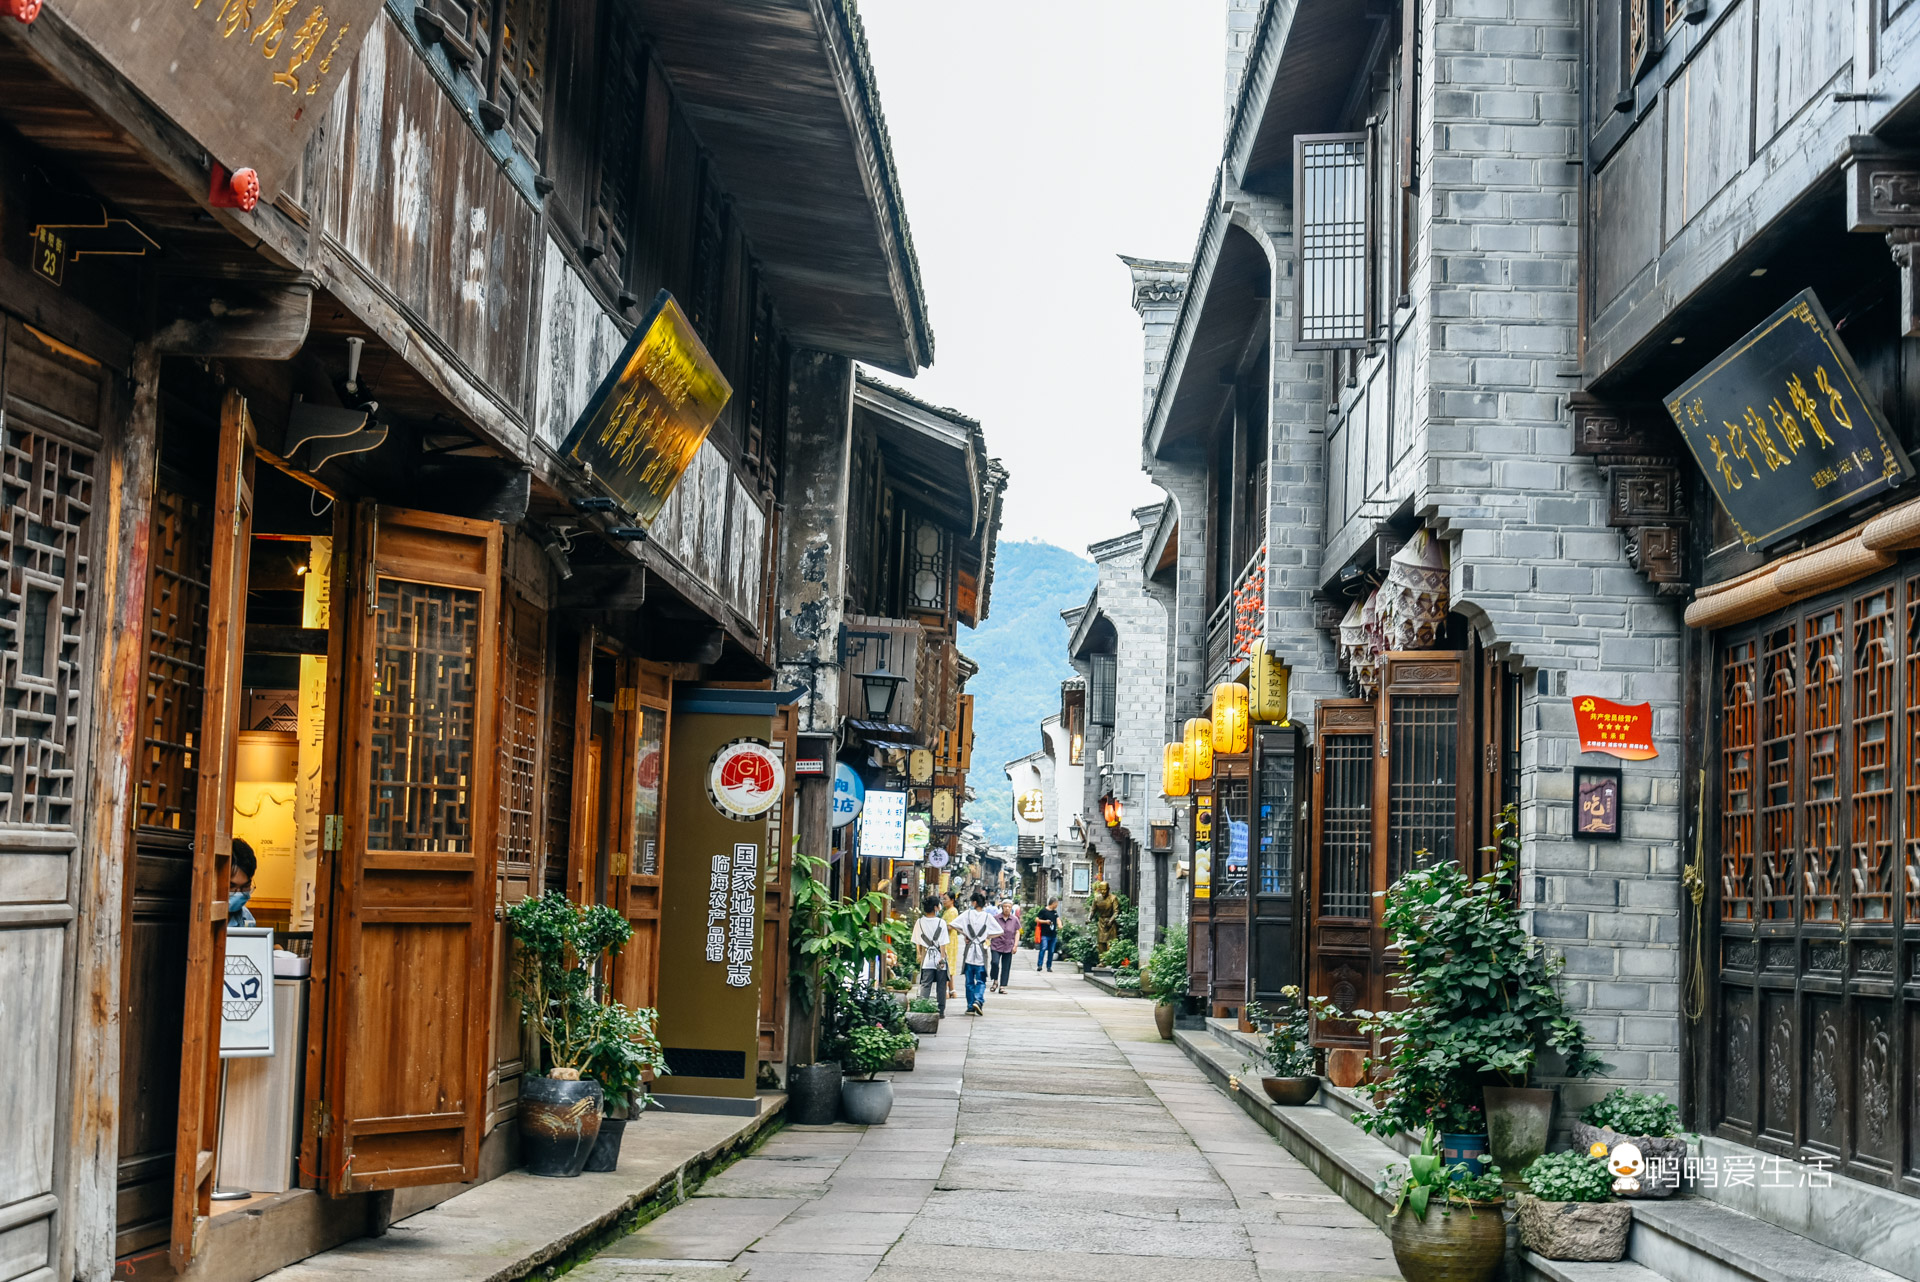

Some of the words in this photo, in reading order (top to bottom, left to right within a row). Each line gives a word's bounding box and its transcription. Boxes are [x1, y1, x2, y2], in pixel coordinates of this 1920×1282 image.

[43, 249, 56, 276] 23
[1590, 713, 1639, 723] 共产党员经营户
[738, 759, 759, 776] GI
[1583, 794, 1605, 816] 吃
[706, 854, 731, 962] 临海农产品馆
[726, 843, 758, 987] 国家地理标志
